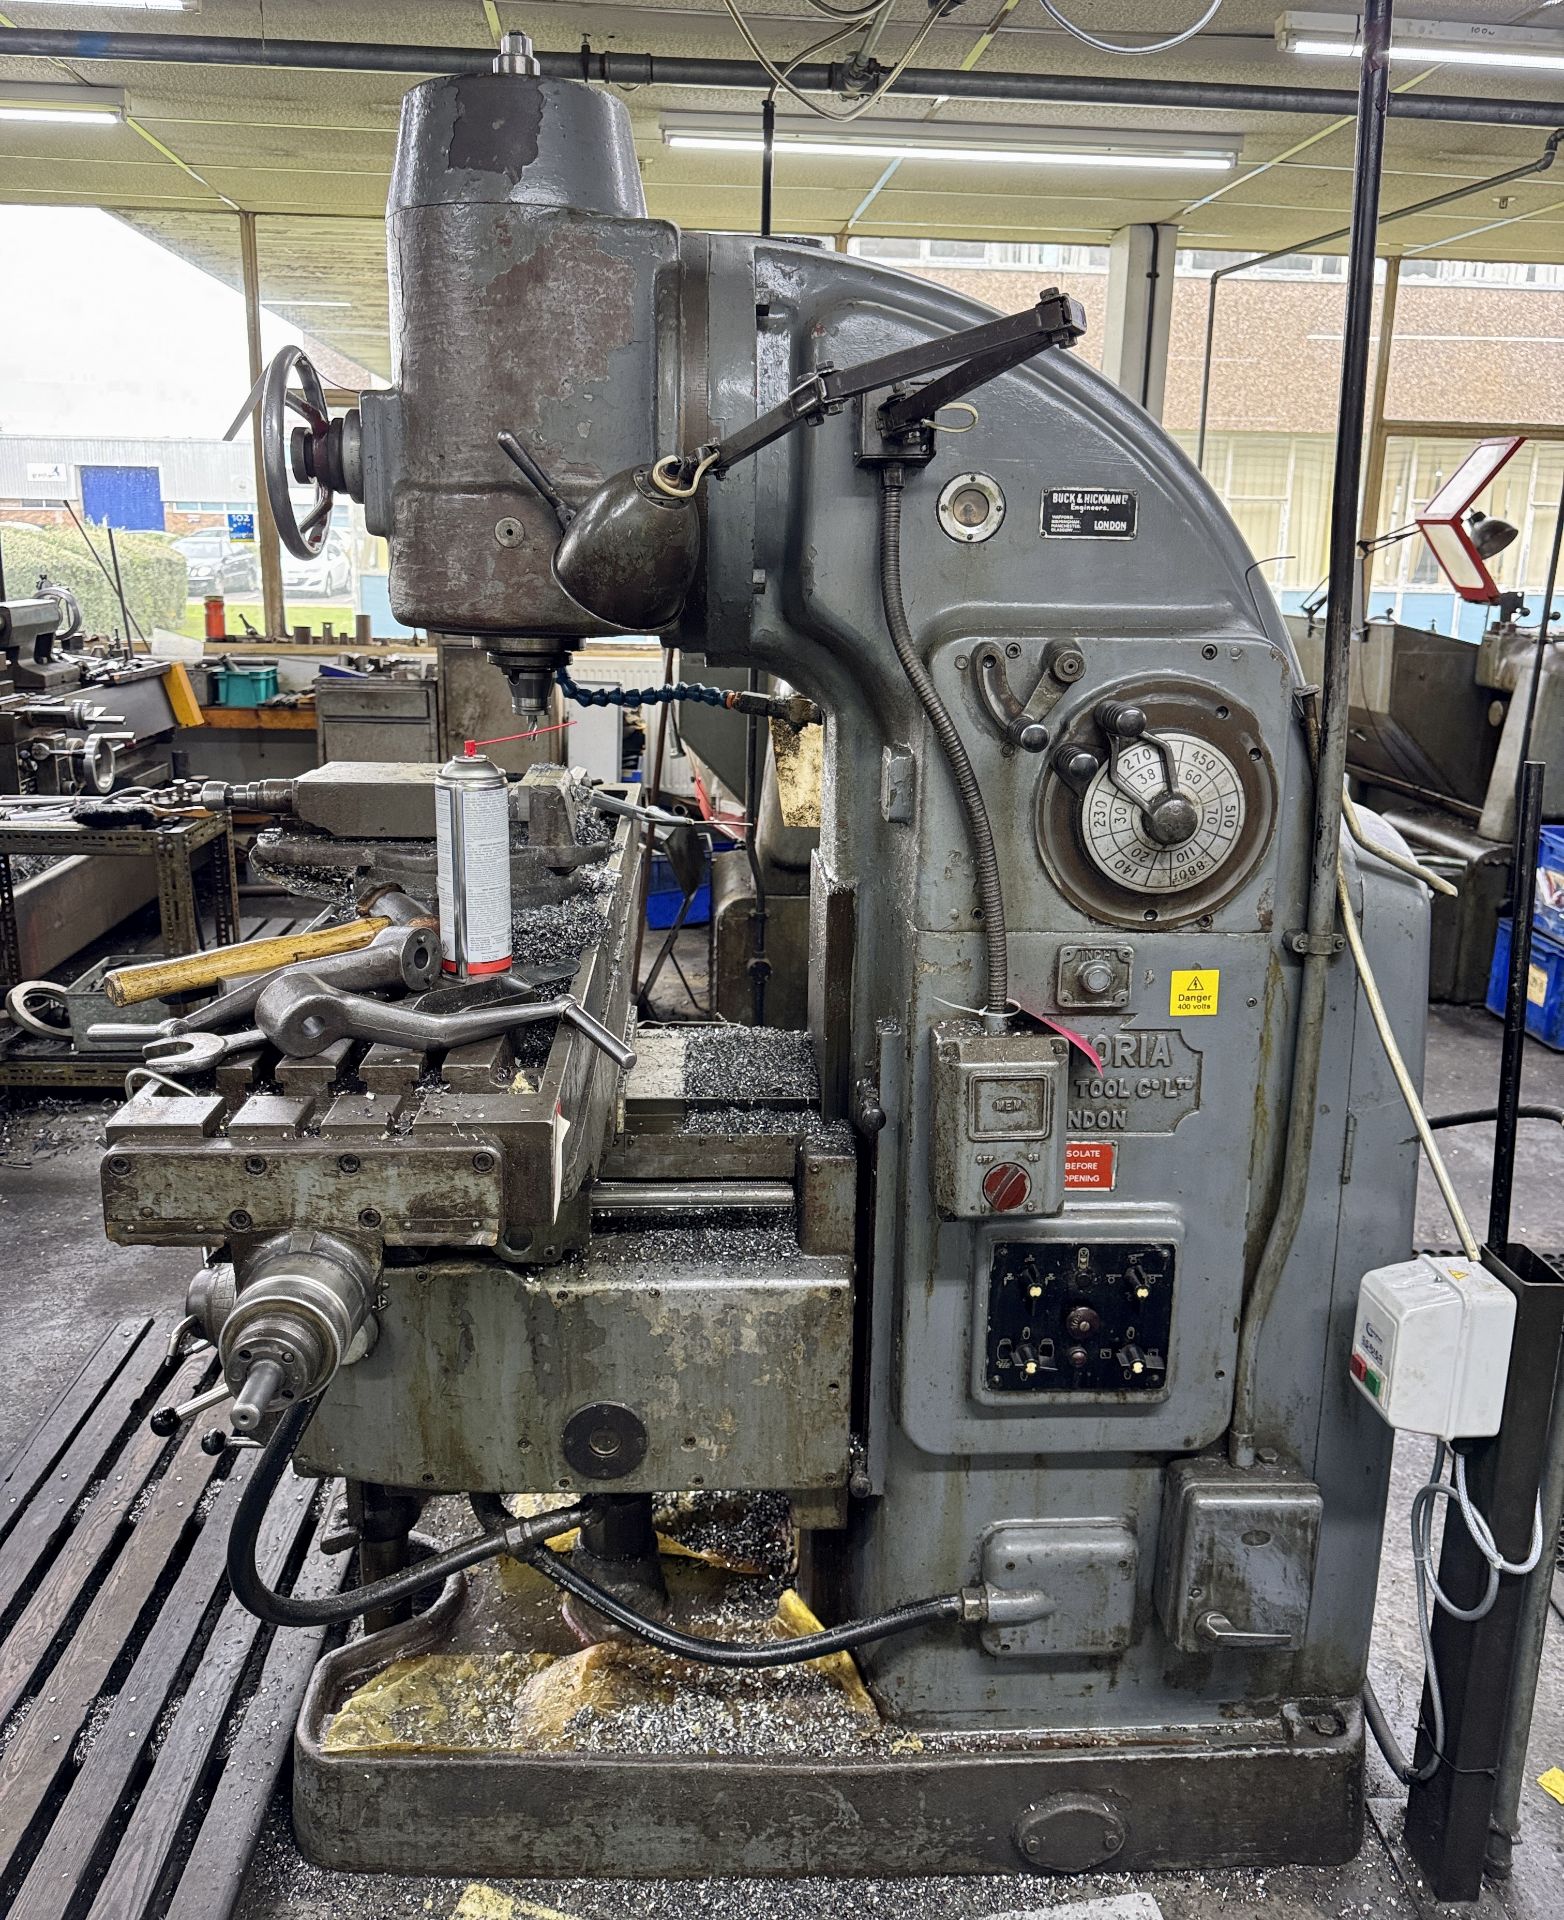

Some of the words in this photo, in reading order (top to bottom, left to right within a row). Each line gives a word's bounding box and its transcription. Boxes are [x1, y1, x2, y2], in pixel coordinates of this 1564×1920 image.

[1052, 492, 1075, 504] BUCK
[1077, 493, 1083, 504] &
[1084, 493, 1121, 505] HICKMAN
[231, 514, 251, 522] 102
[1094, 520, 1127, 531] LONDON
[1123, 748, 1152, 771] 270
[1191, 749, 1216, 772] 450
[1137, 768, 1156, 785] 38
[1185, 768, 1201, 785] 60
[1093, 800, 1108, 828] 230
[1114, 807, 1127, 824] 30
[1206, 807, 1218, 825] 70
[1223, 805, 1236, 829] 510
[1131, 847, 1150, 863] 20
[1176, 846, 1196, 863] 110
[1114, 859, 1139, 878] 140
[1079, 949, 1112, 962] INCH
[1178, 994, 1212, 1003] Danger
[1087, 1033, 1172, 1068] ORIA
[1074, 1077, 1131, 1099] TOOL
[995, 1099, 1023, 1111] MEM
[1067, 1109, 1128, 1129] NDON
[976, 1155, 994, 1163] OFF
[1027, 1153, 1039, 1161] ON
[1065, 1149, 1101, 1158] SOLATE
[1064, 1162, 1098, 1170] BEFORE
